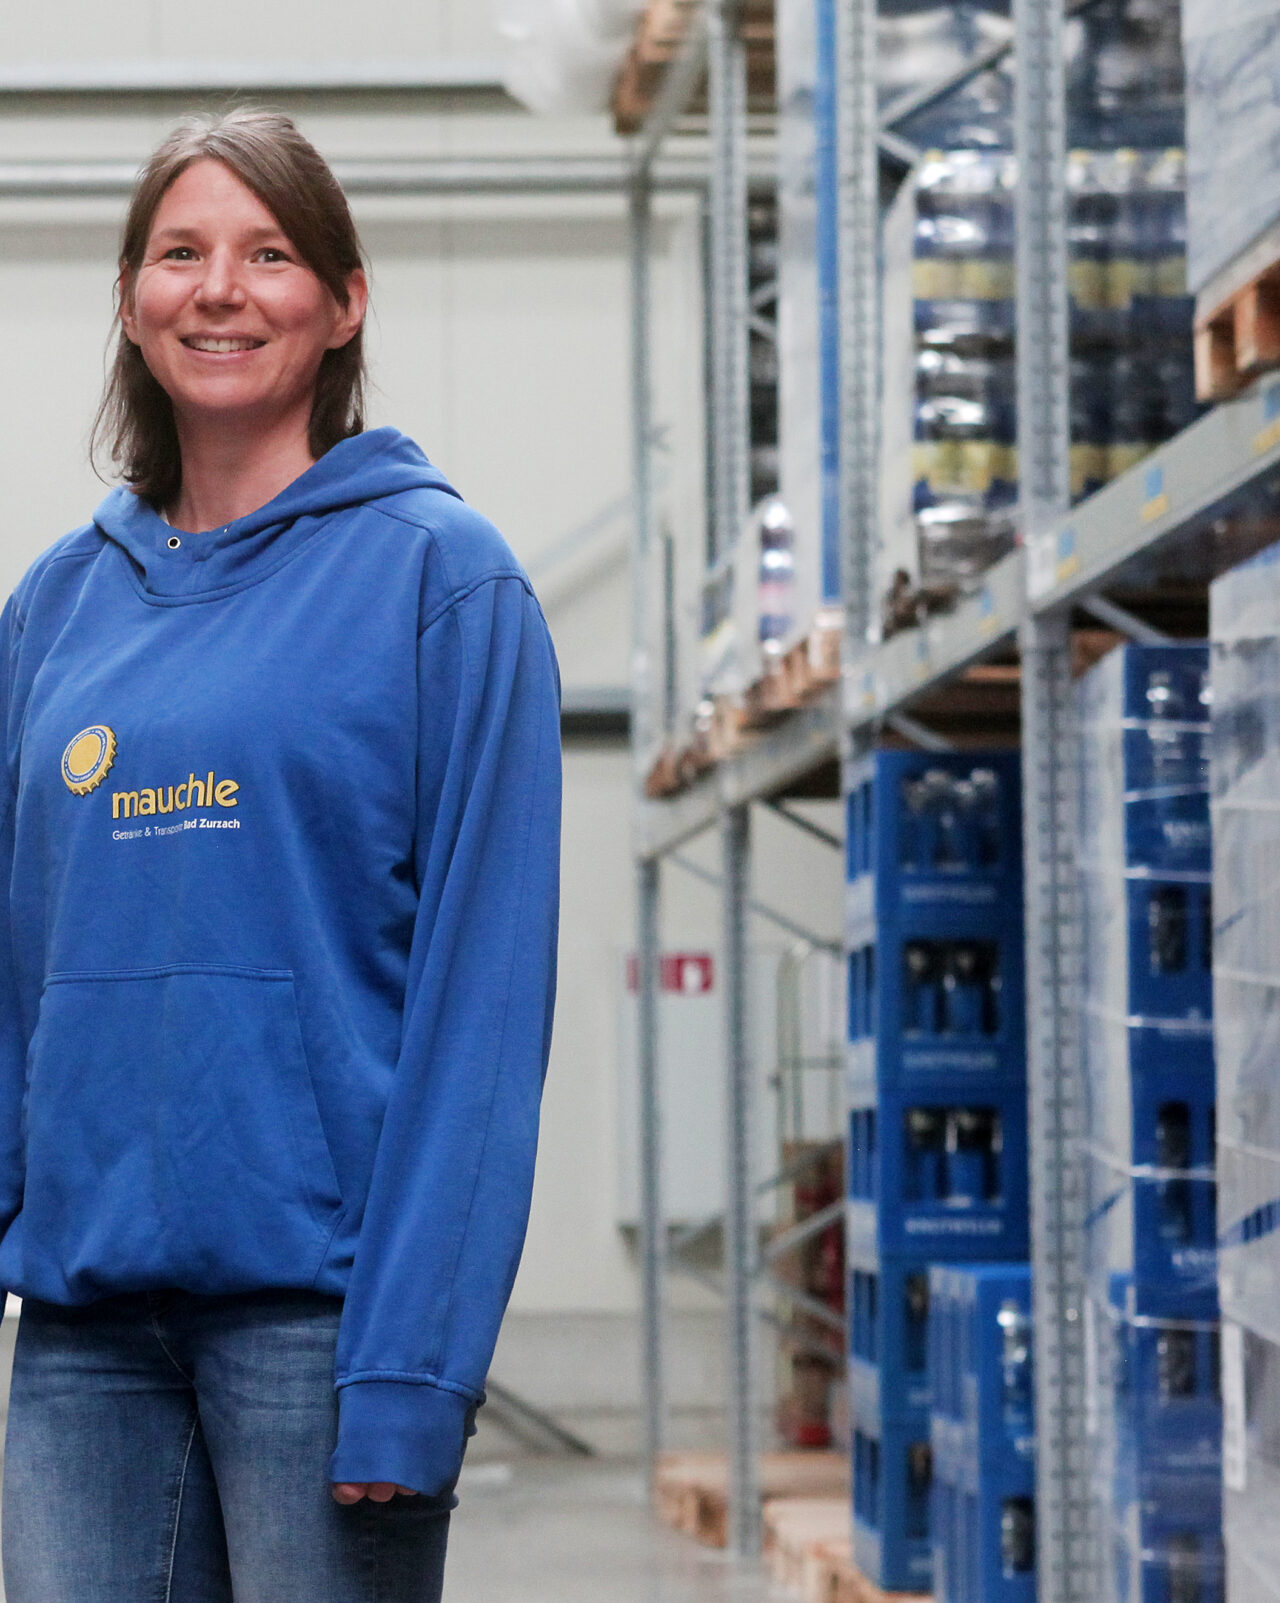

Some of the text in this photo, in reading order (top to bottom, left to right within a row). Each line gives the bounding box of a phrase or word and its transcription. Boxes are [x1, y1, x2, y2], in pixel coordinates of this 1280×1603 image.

[112, 771, 240, 819] mauchle
[144, 826, 152, 838] &
[183, 818, 197, 830] Bad
[199, 818, 240, 830] Zurzach
